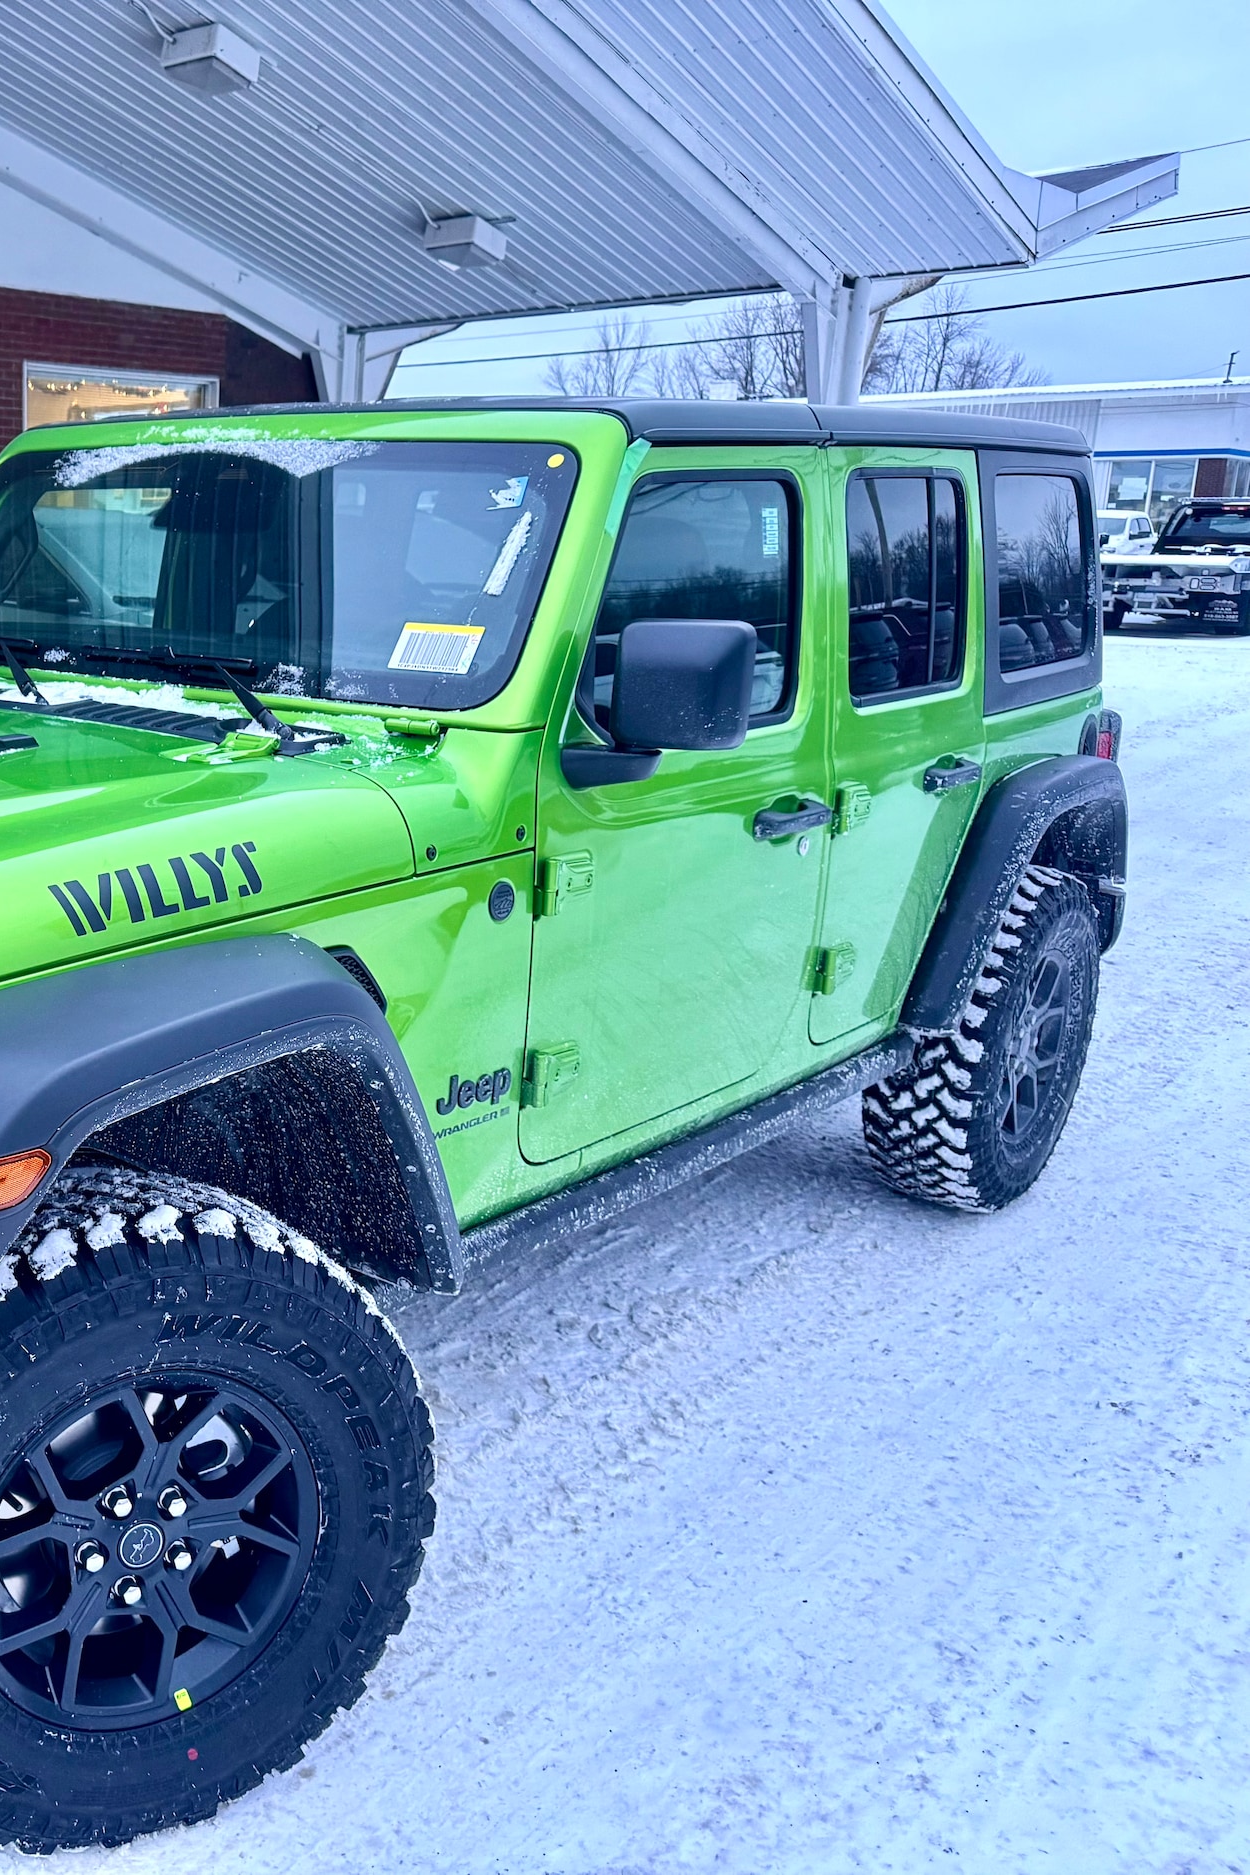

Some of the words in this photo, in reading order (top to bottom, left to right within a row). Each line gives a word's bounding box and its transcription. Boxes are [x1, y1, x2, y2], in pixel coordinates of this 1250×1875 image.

[47, 841, 263, 937] WILLYS
[433, 1110, 499, 1141] WRANGLER
[436, 1066, 512, 1116] Jeep
[152, 1313, 393, 1548] WILDPEAK
